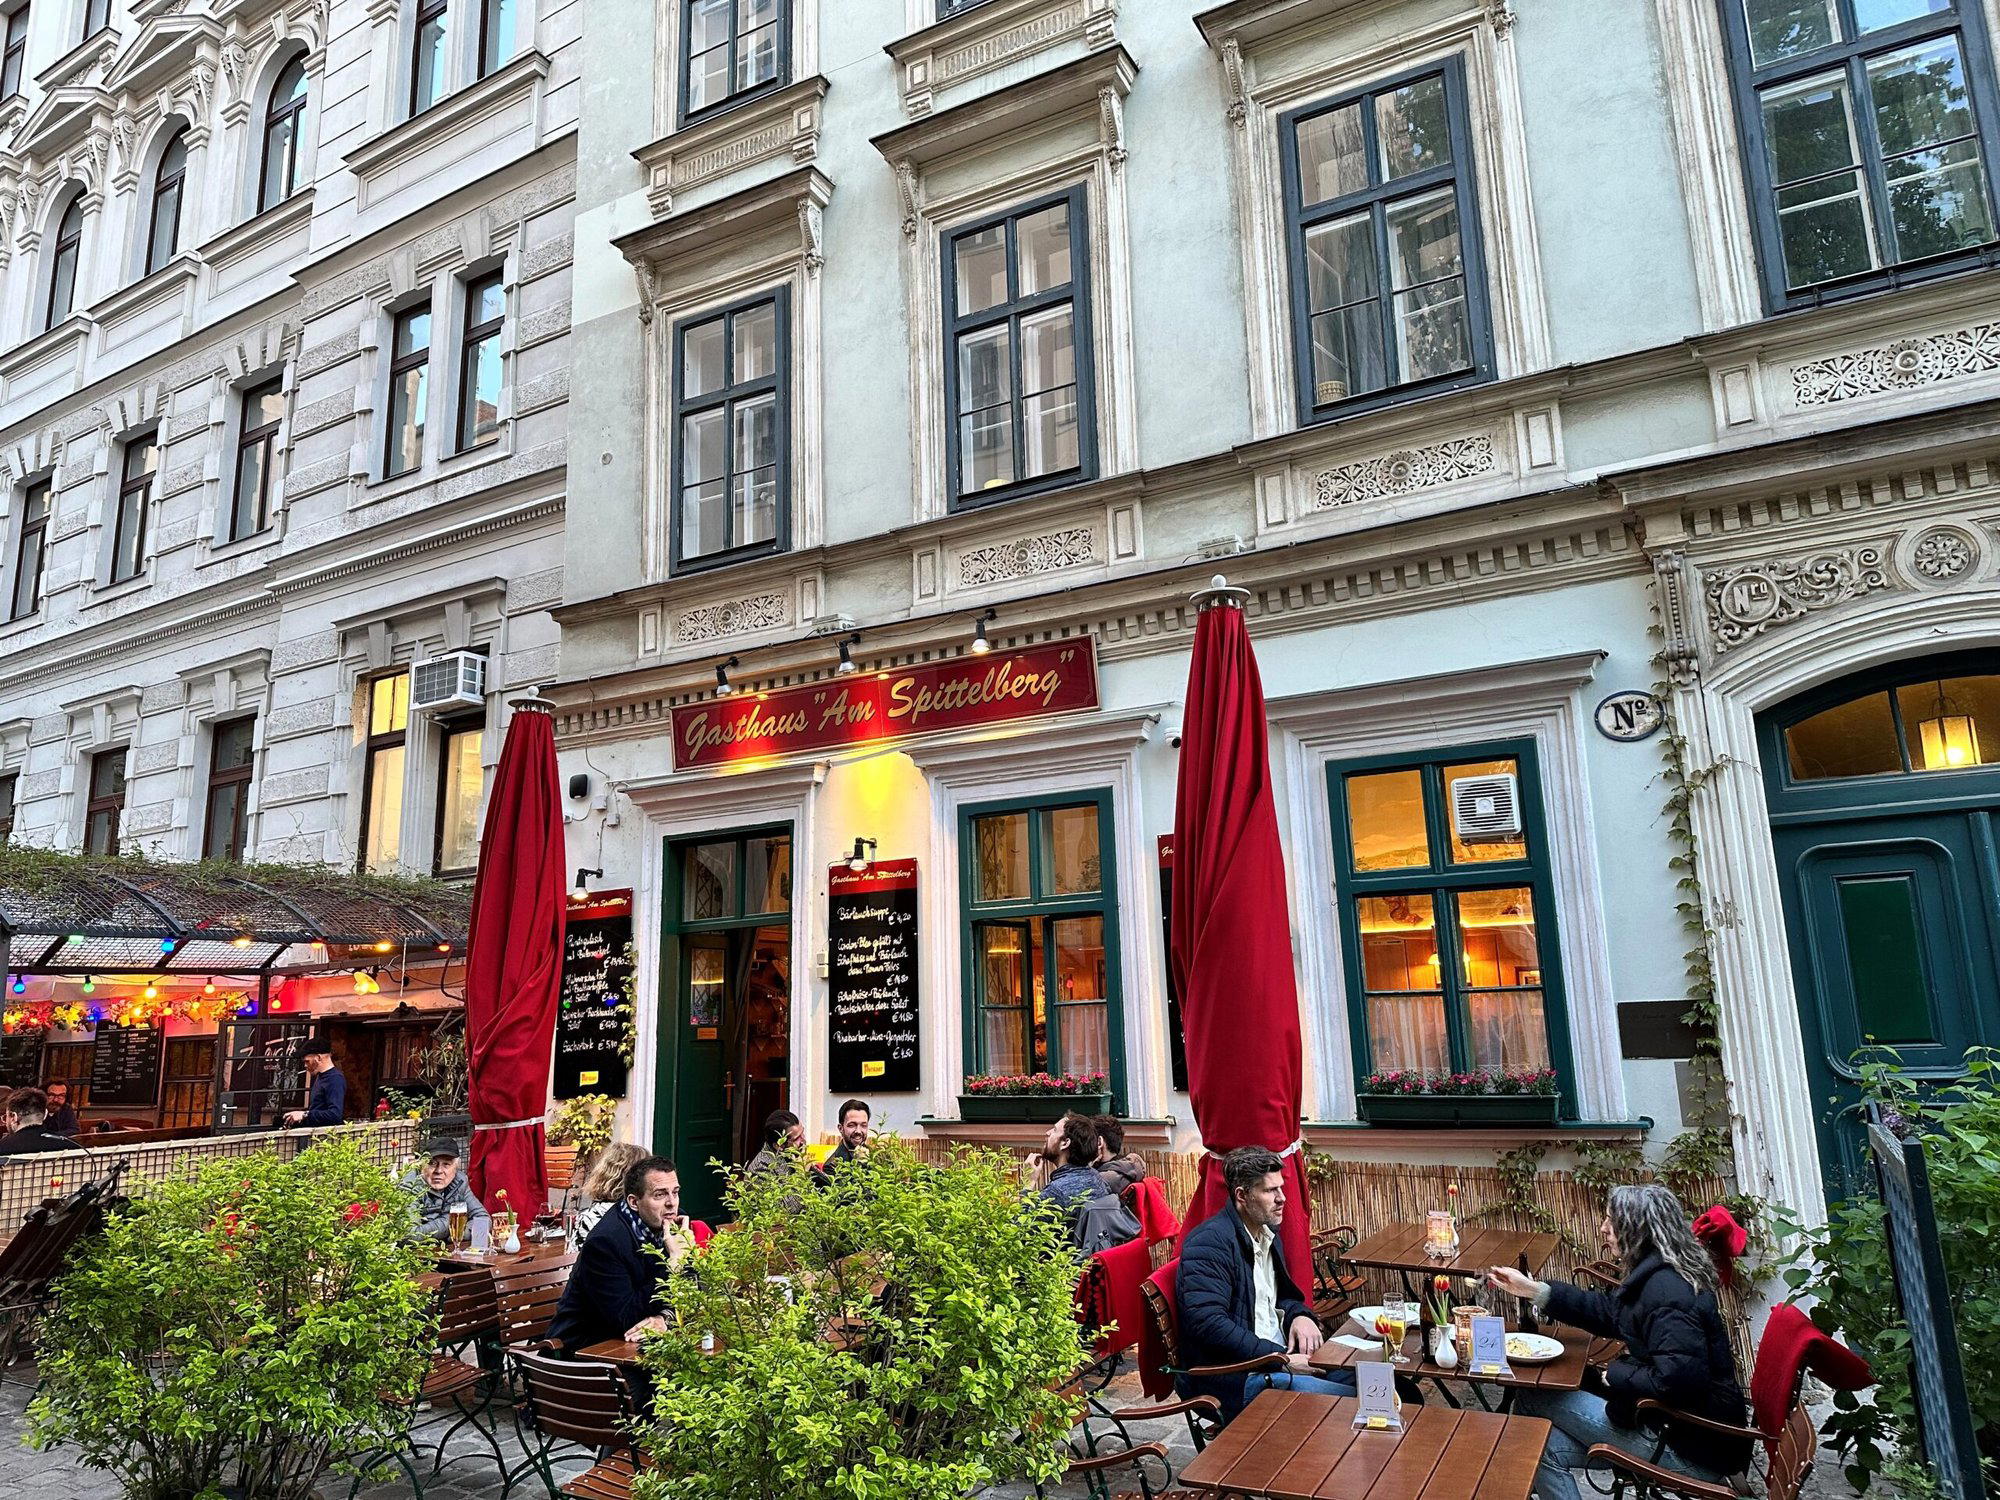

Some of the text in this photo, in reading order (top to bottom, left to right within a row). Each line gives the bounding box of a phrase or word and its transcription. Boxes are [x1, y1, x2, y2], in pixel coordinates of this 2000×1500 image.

[685, 649, 1075, 761] Gasthaus "Am Spittelberg"
[1366, 1384, 1388, 1399] 23
